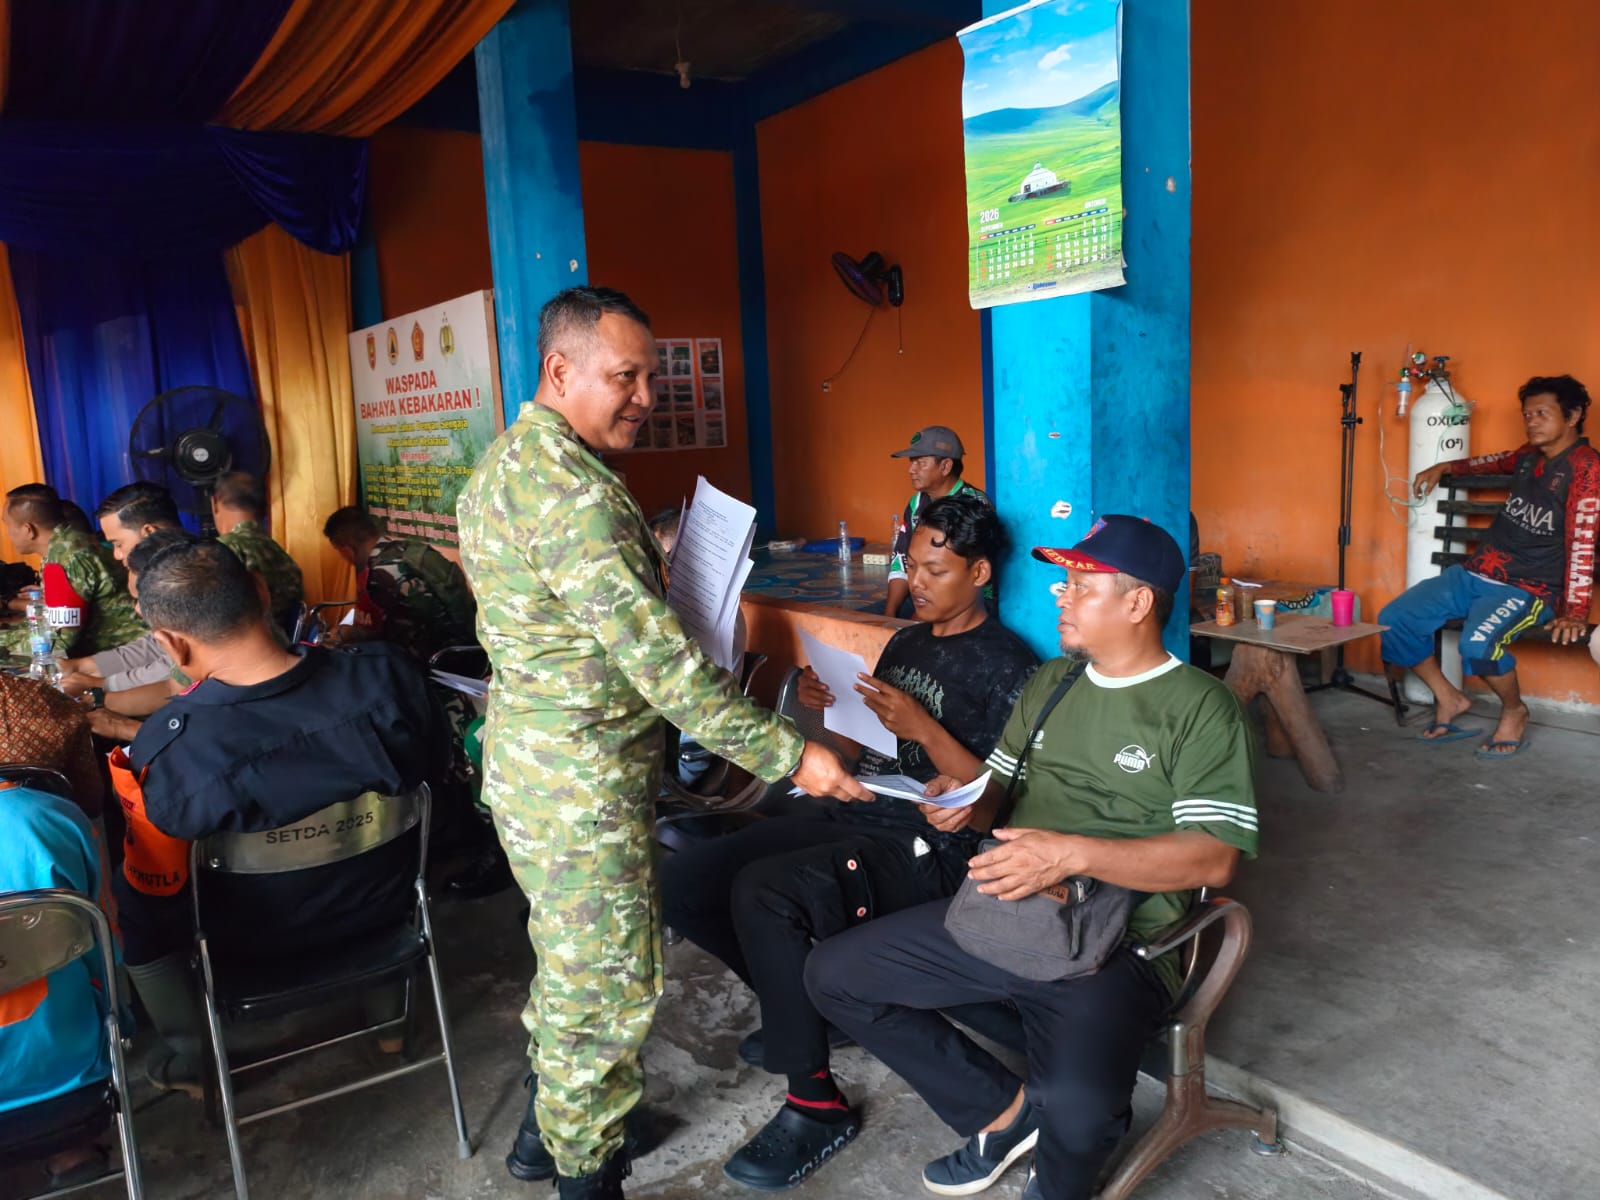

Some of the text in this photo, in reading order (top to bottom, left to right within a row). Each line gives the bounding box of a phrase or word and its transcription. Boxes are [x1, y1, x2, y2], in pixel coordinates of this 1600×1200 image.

[979, 208, 1000, 224] 2026
[386, 370, 437, 395] WASPADA
[360, 400, 397, 420] BAHAYA
[398, 388, 473, 415] KEBAKARAN
[1470, 598, 1525, 641] TAGANA
[266, 811, 374, 844] SETDA 2025
